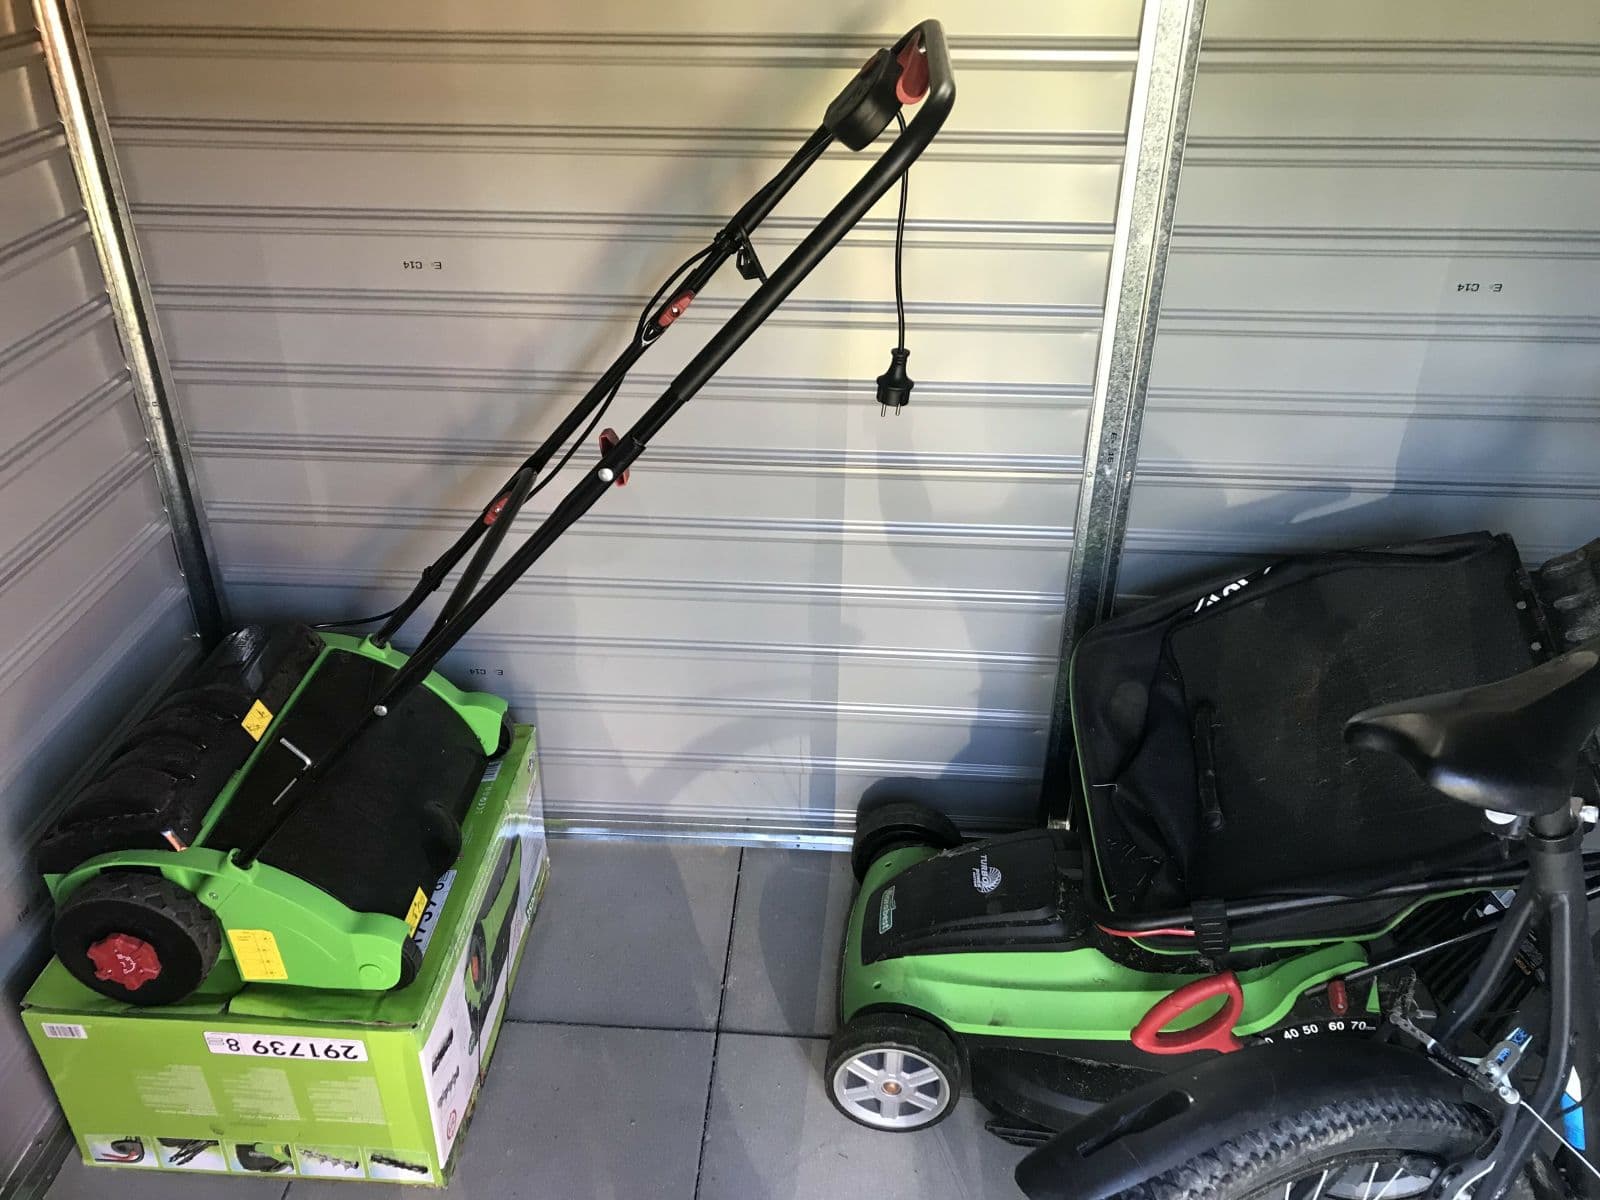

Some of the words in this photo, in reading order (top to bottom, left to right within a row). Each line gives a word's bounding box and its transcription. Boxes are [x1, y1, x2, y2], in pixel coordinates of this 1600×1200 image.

[403, 261, 422, 269] C14
[1457, 283, 1480, 292] C14
[1283, 1028, 1300, 1040] 40
[1301, 1024, 1319, 1035] 50
[1328, 1021, 1345, 1031] 60
[225, 1038, 241, 1052] 8
[252, 1040, 359, 1060] 291739
